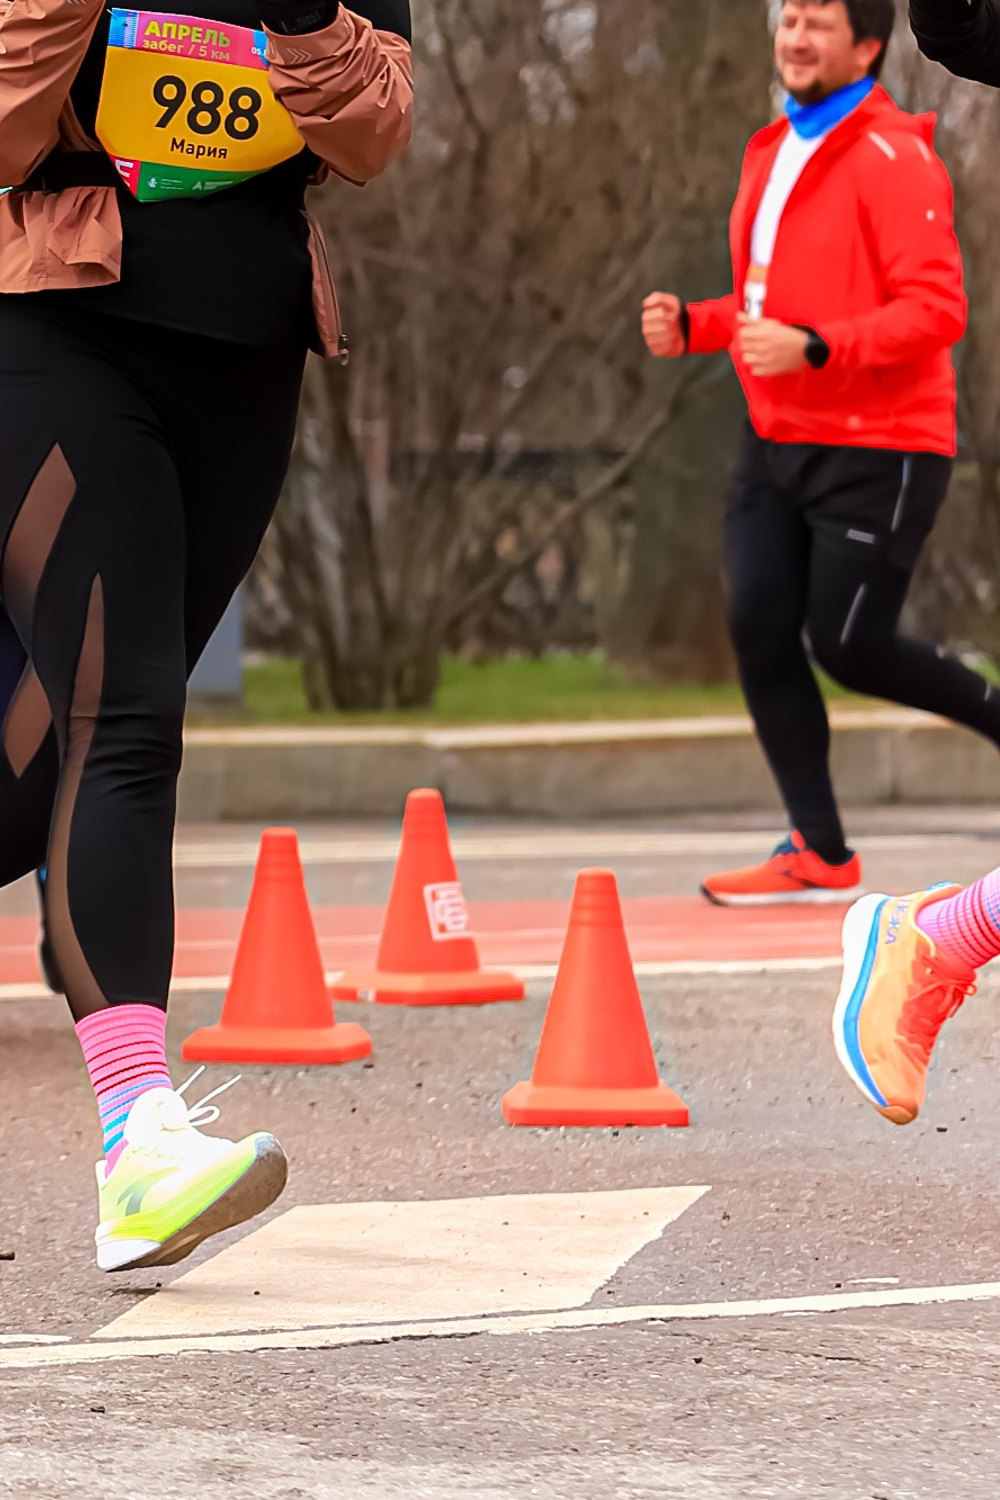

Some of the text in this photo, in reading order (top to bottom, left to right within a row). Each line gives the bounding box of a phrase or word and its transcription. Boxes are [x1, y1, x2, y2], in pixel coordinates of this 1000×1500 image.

[144, 20, 231, 48] АПРЕЛЬ
[142, 39, 185, 54] забег
[198, 45, 208, 57] 5
[211, 49, 230, 61] км
[153, 74, 262, 141] 988
[170, 137, 228, 160] Мария
